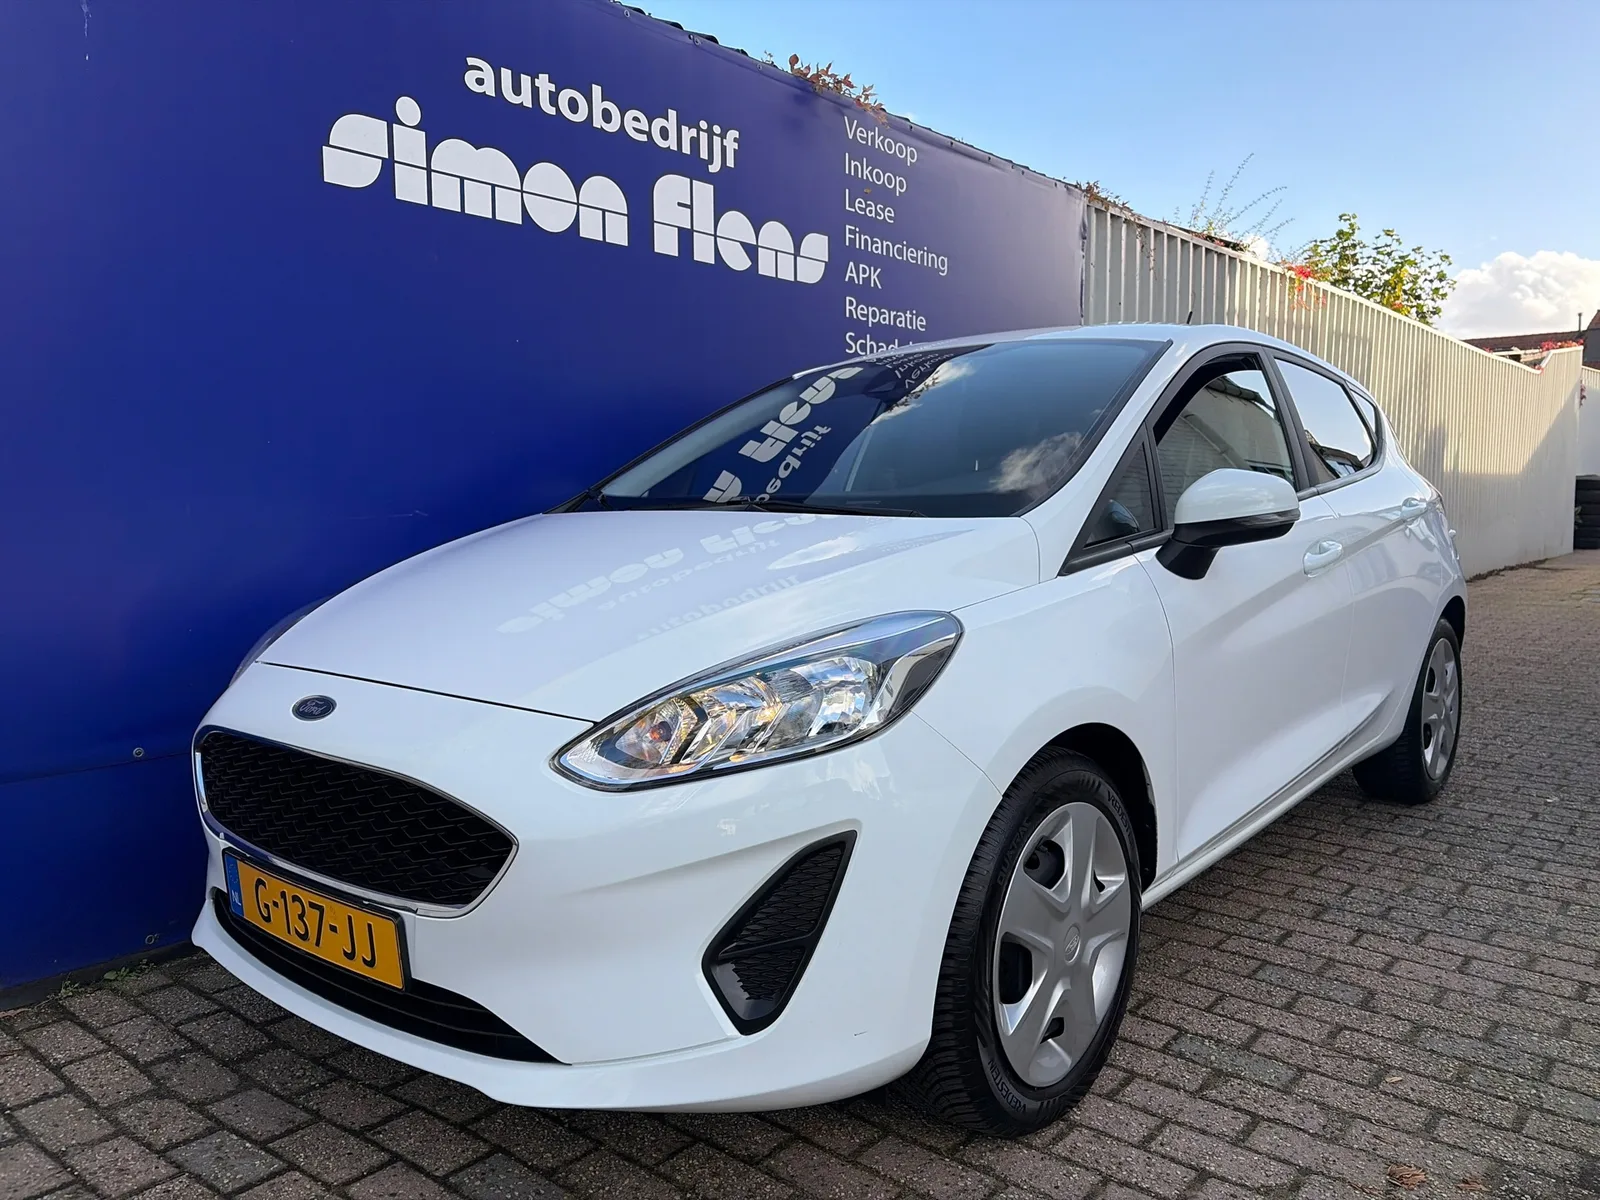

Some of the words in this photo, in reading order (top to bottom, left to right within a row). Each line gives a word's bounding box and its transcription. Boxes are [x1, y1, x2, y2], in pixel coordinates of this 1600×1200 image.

[464, 57, 739, 173] autobedrijf
[844, 116, 918, 166] Verkoop
[322, 96, 628, 246] simon
[653, 174, 829, 284] flens
[845, 152, 907, 196] Inkoop
[845, 188, 895, 223] Lease
[845, 224, 948, 276] Financiering
[845, 261, 882, 289] APK
[845, 296, 926, 331] Reparatie
[300, 700, 327, 715] Ford
[232, 889, 242, 907] NL
[254, 878, 377, 968] G-137-JJ
